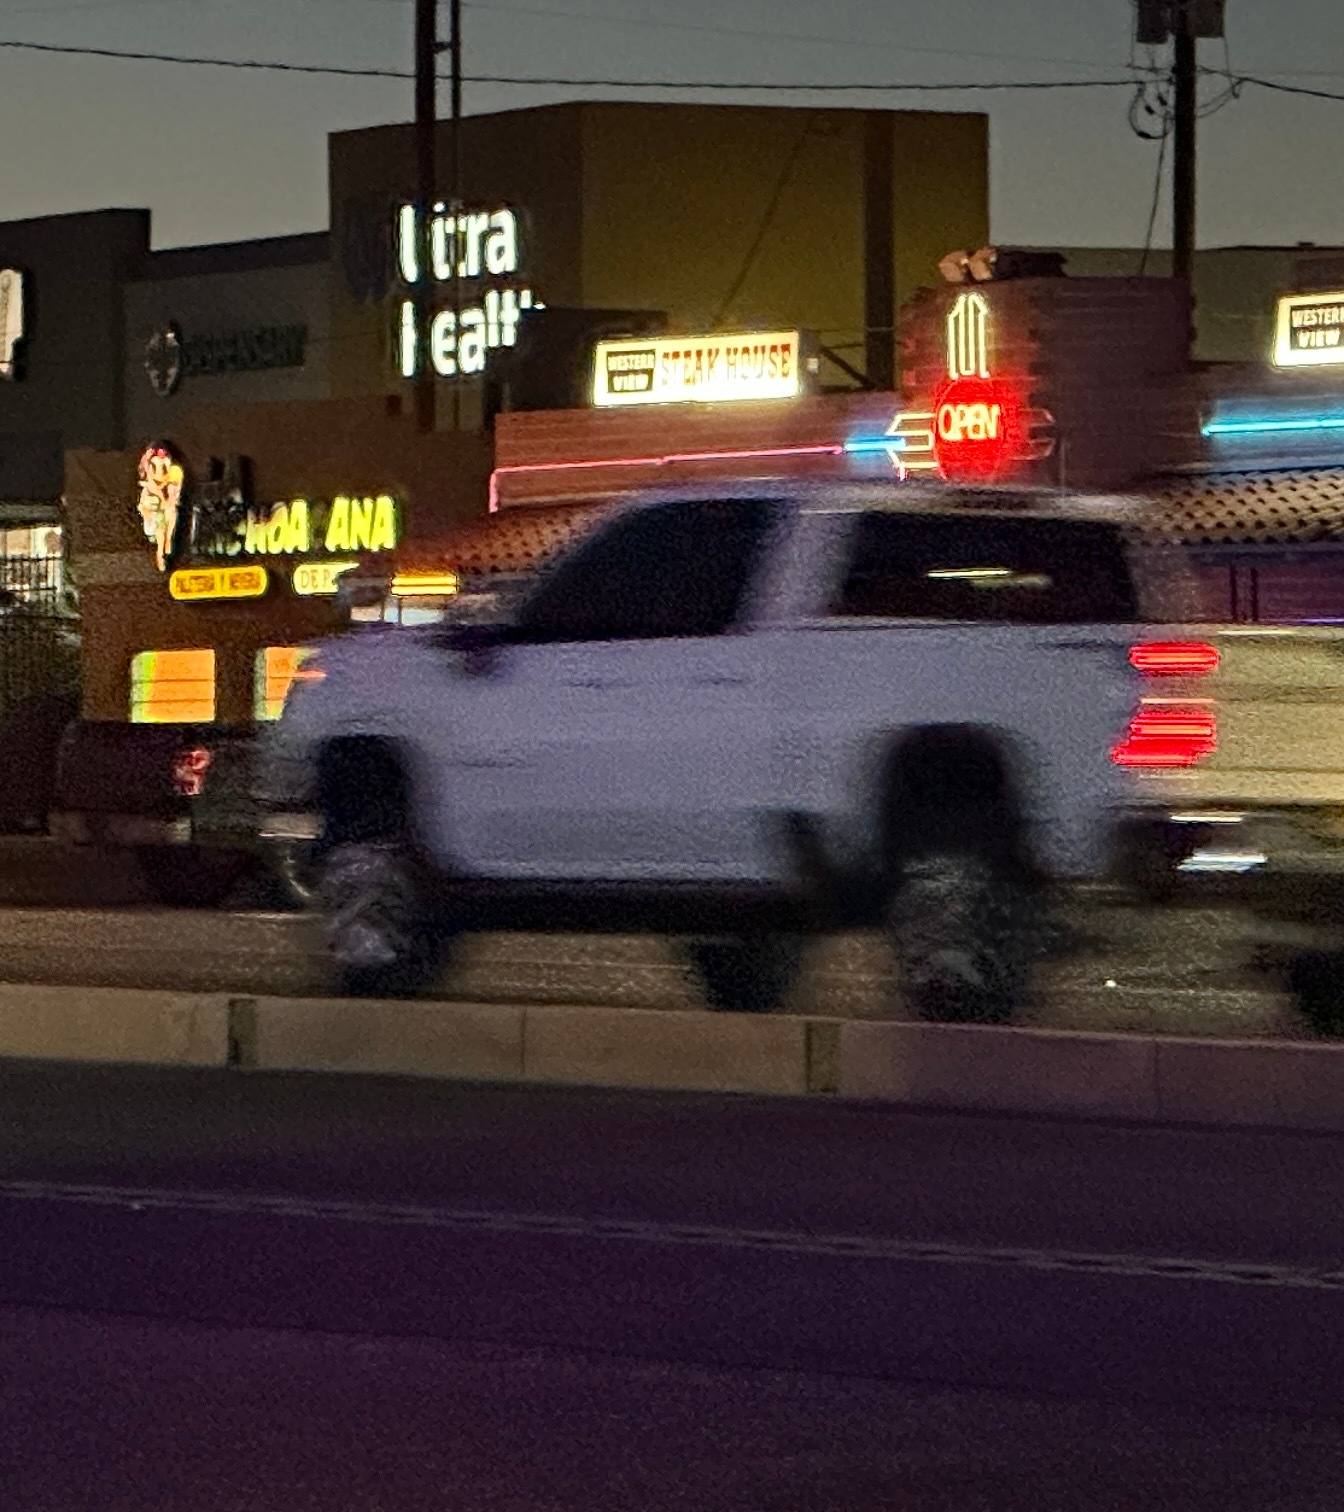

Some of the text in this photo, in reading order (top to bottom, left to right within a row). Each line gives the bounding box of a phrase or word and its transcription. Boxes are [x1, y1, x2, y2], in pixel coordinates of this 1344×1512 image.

[1297, 327, 1341, 348] VIEW
[725, 343, 792, 381] HOUSE
[938, 402, 1001, 441] OPEN
